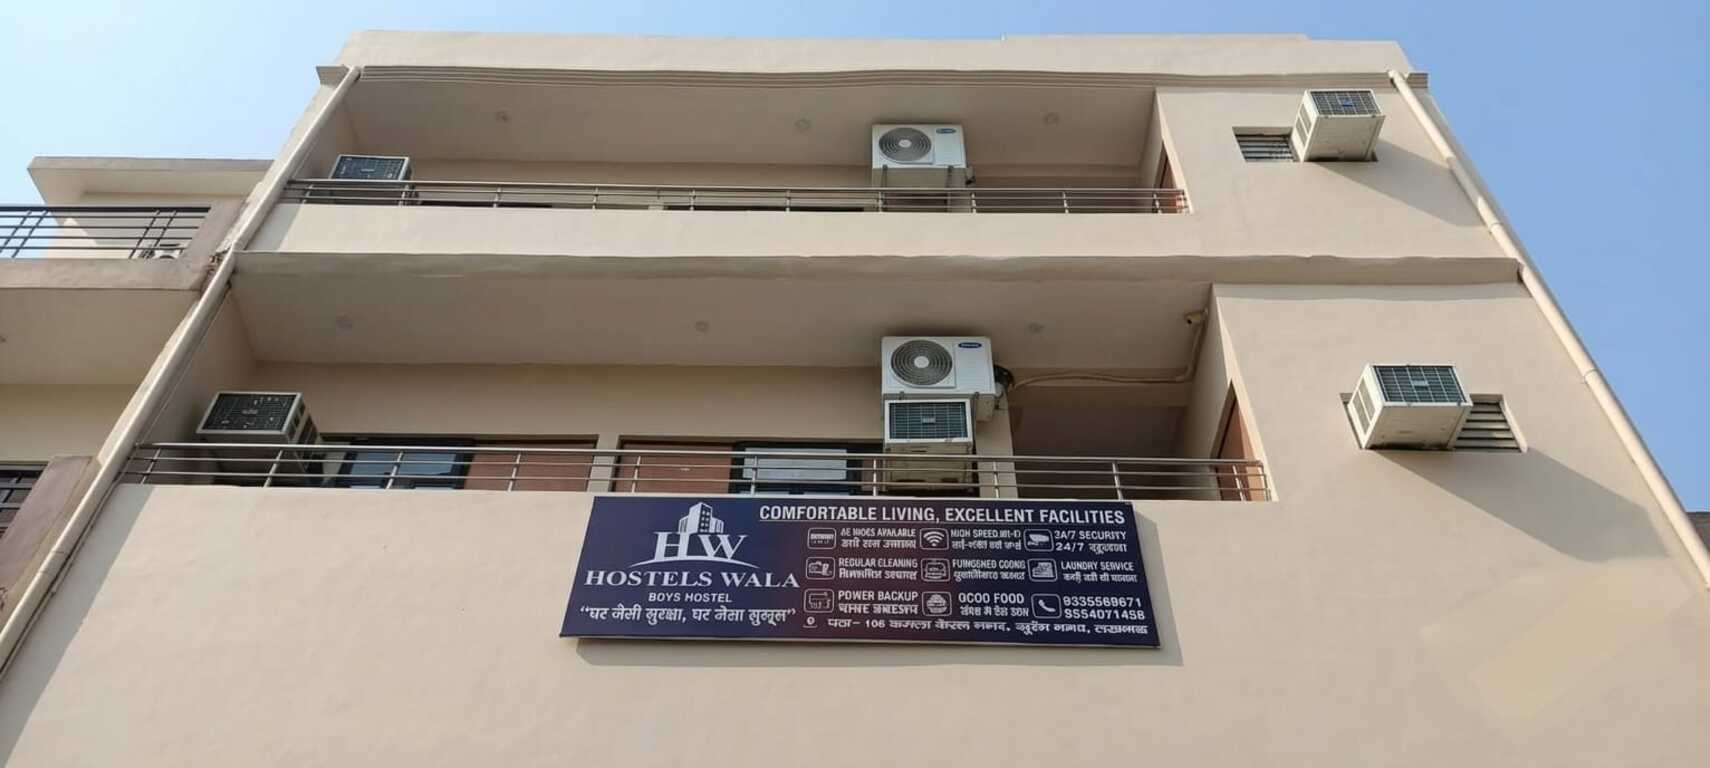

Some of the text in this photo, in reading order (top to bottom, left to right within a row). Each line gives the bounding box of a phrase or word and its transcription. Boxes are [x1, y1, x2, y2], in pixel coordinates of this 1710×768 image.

[759, 505, 1126, 525] COMFORTABLE LIVING, EXCELLENT FACILITIES
[1079, 530, 1127, 541] SECURITY
[653, 531, 748, 561] HW
[1055, 541, 1084, 552] 24/7
[1061, 561, 1135, 572] LAUNDRY SERVICE
[584, 570, 800, 589] HOSTELS WALA
[648, 592, 733, 604] BOYS HOSTEL
[838, 590, 919, 602] POWER BACKUP
[993, 593, 1025, 605] FOOD
